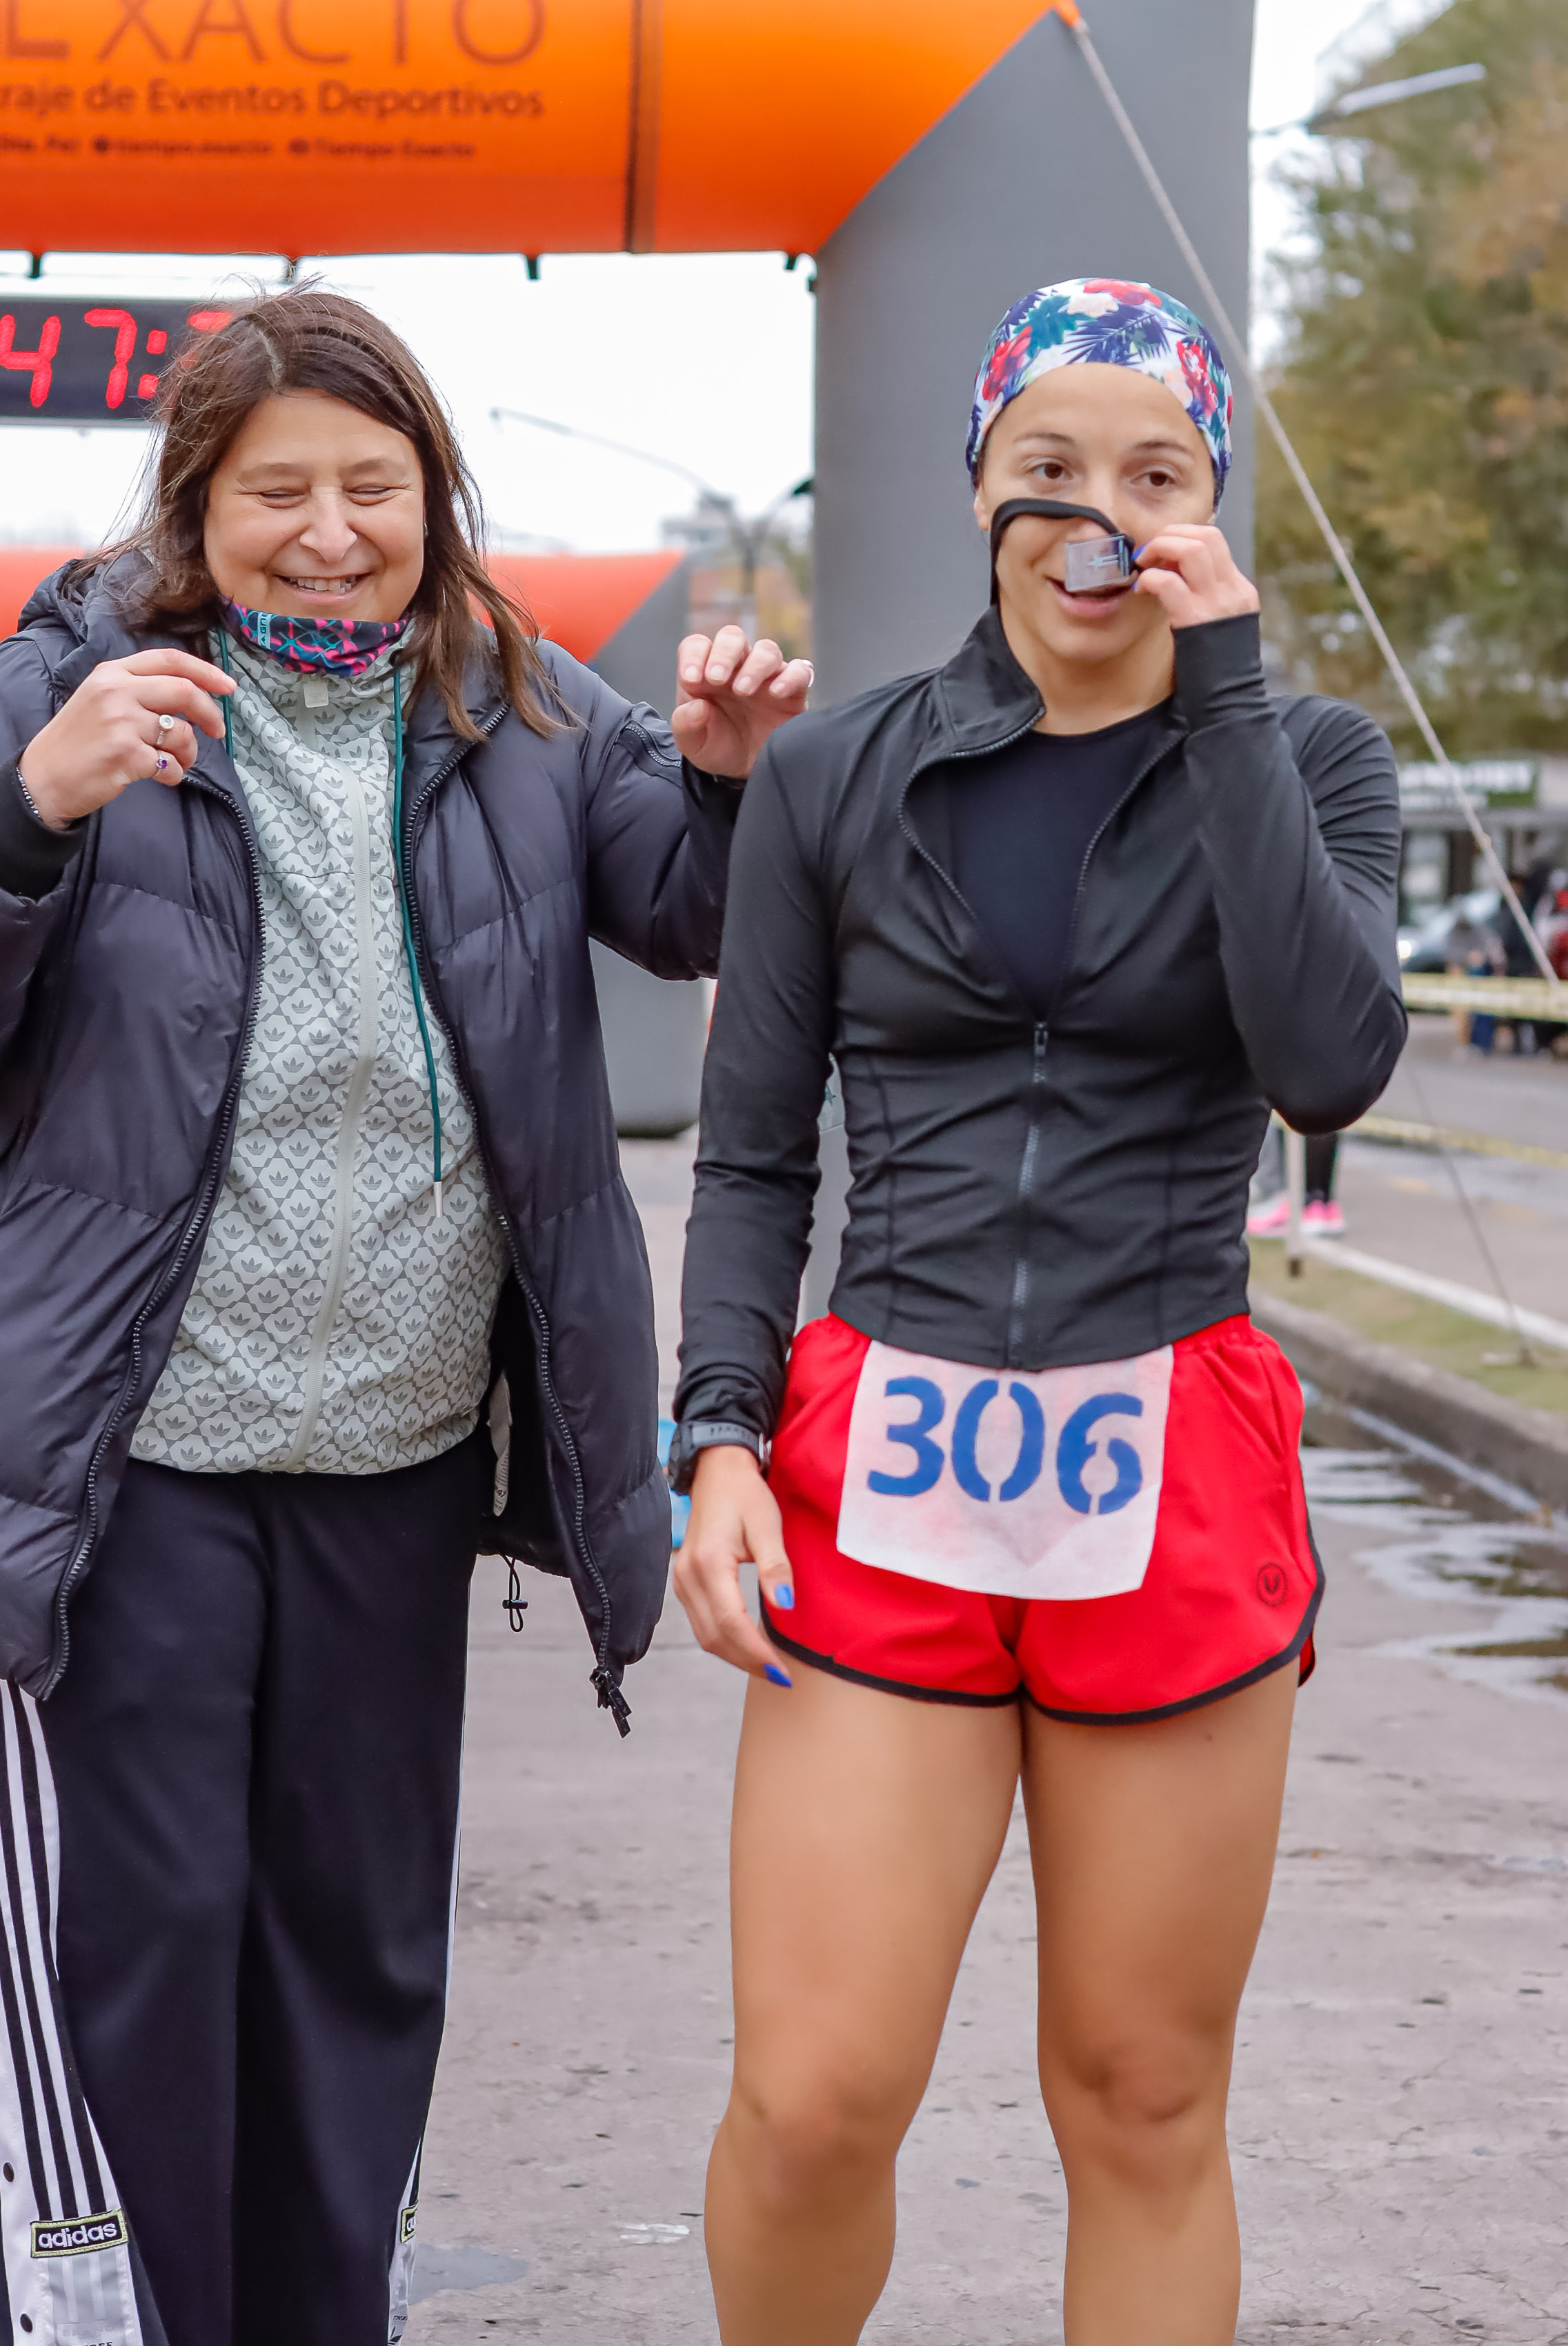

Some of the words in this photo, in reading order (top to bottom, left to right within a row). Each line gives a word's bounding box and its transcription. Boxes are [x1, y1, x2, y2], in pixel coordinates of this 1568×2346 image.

[83, 77, 137, 112] de
[146, 77, 308, 116] Eventos
[317, 79, 545, 120] Deportivos
[867, 1375, 1143, 1515] 306
[38, 2223, 117, 2249] adidas
